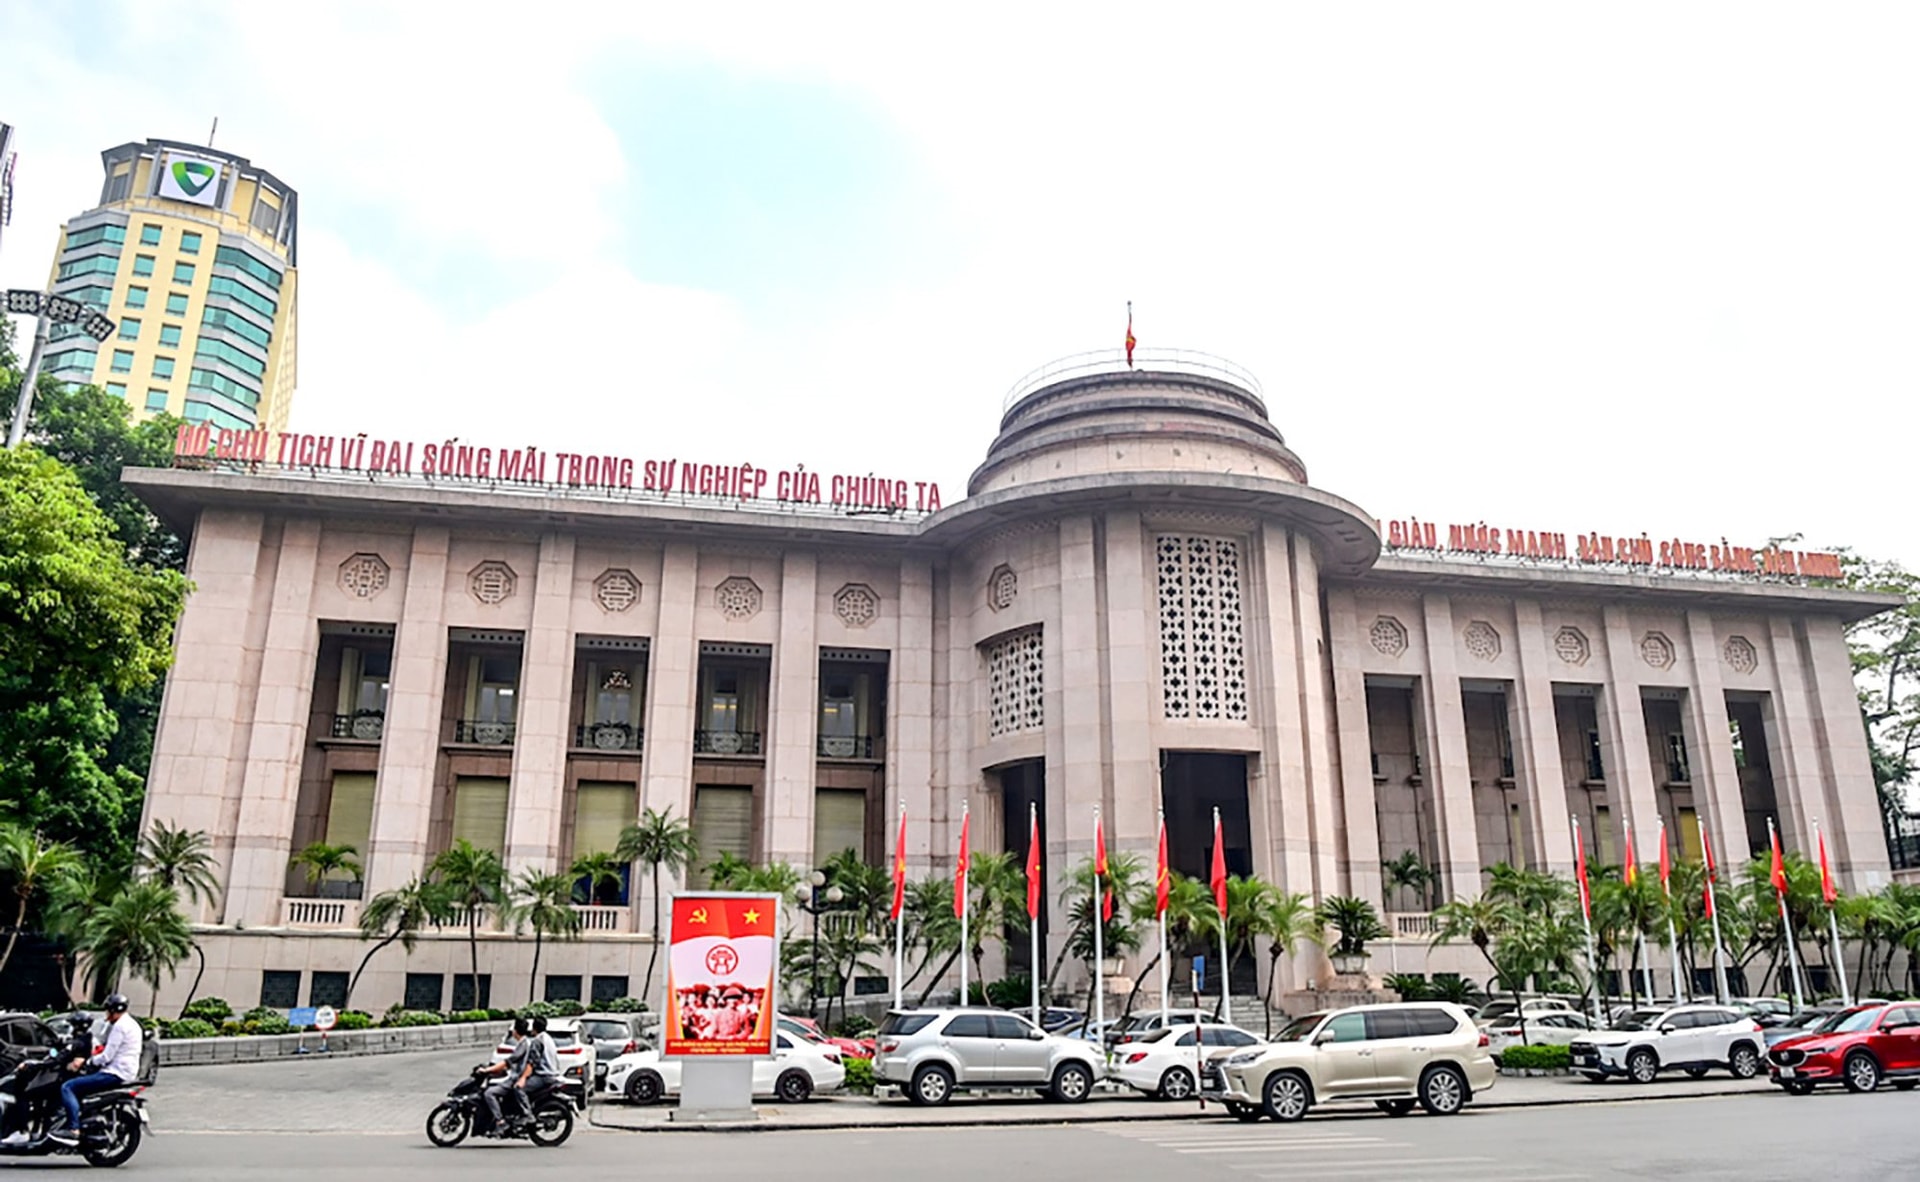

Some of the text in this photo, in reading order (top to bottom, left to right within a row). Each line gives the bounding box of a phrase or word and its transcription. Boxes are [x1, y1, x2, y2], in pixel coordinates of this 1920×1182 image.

[215, 422, 269, 461] CHỦ
[278, 432, 334, 470] TỊCH
[340, 433, 367, 469] VĨ
[370, 440, 413, 477] ĐẠI
[421, 437, 491, 478] SỐNG
[498, 446, 546, 483] MÃI
[556, 453, 633, 488] TRONG
[643, 458, 676, 498] SỰ
[681, 462, 767, 503] NGHIỆP
[777, 464, 821, 504] CỦA
[832, 472, 907, 510] CHÚNG
[915, 482, 942, 512] TA
